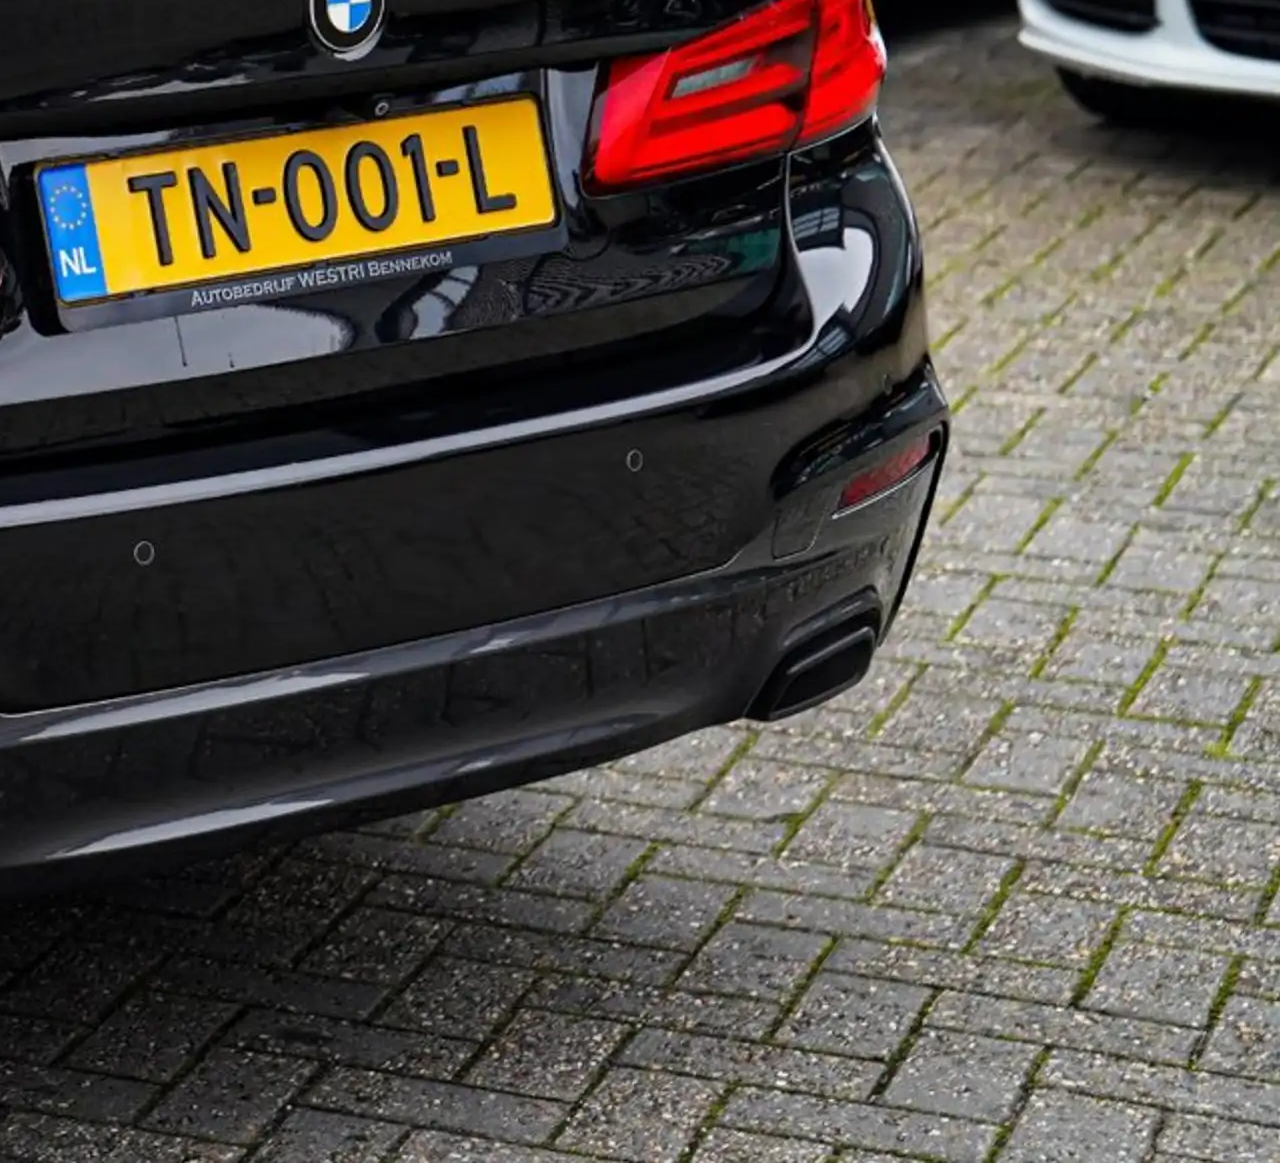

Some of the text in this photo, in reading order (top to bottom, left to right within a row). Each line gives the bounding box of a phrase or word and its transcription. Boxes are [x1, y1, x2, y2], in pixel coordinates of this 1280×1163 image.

[127, 125, 518, 266] TN-001-L
[59, 247, 97, 278] NL
[190, 251, 453, 307] AUTOBEDRIJF WESTRI BENNEKOM
